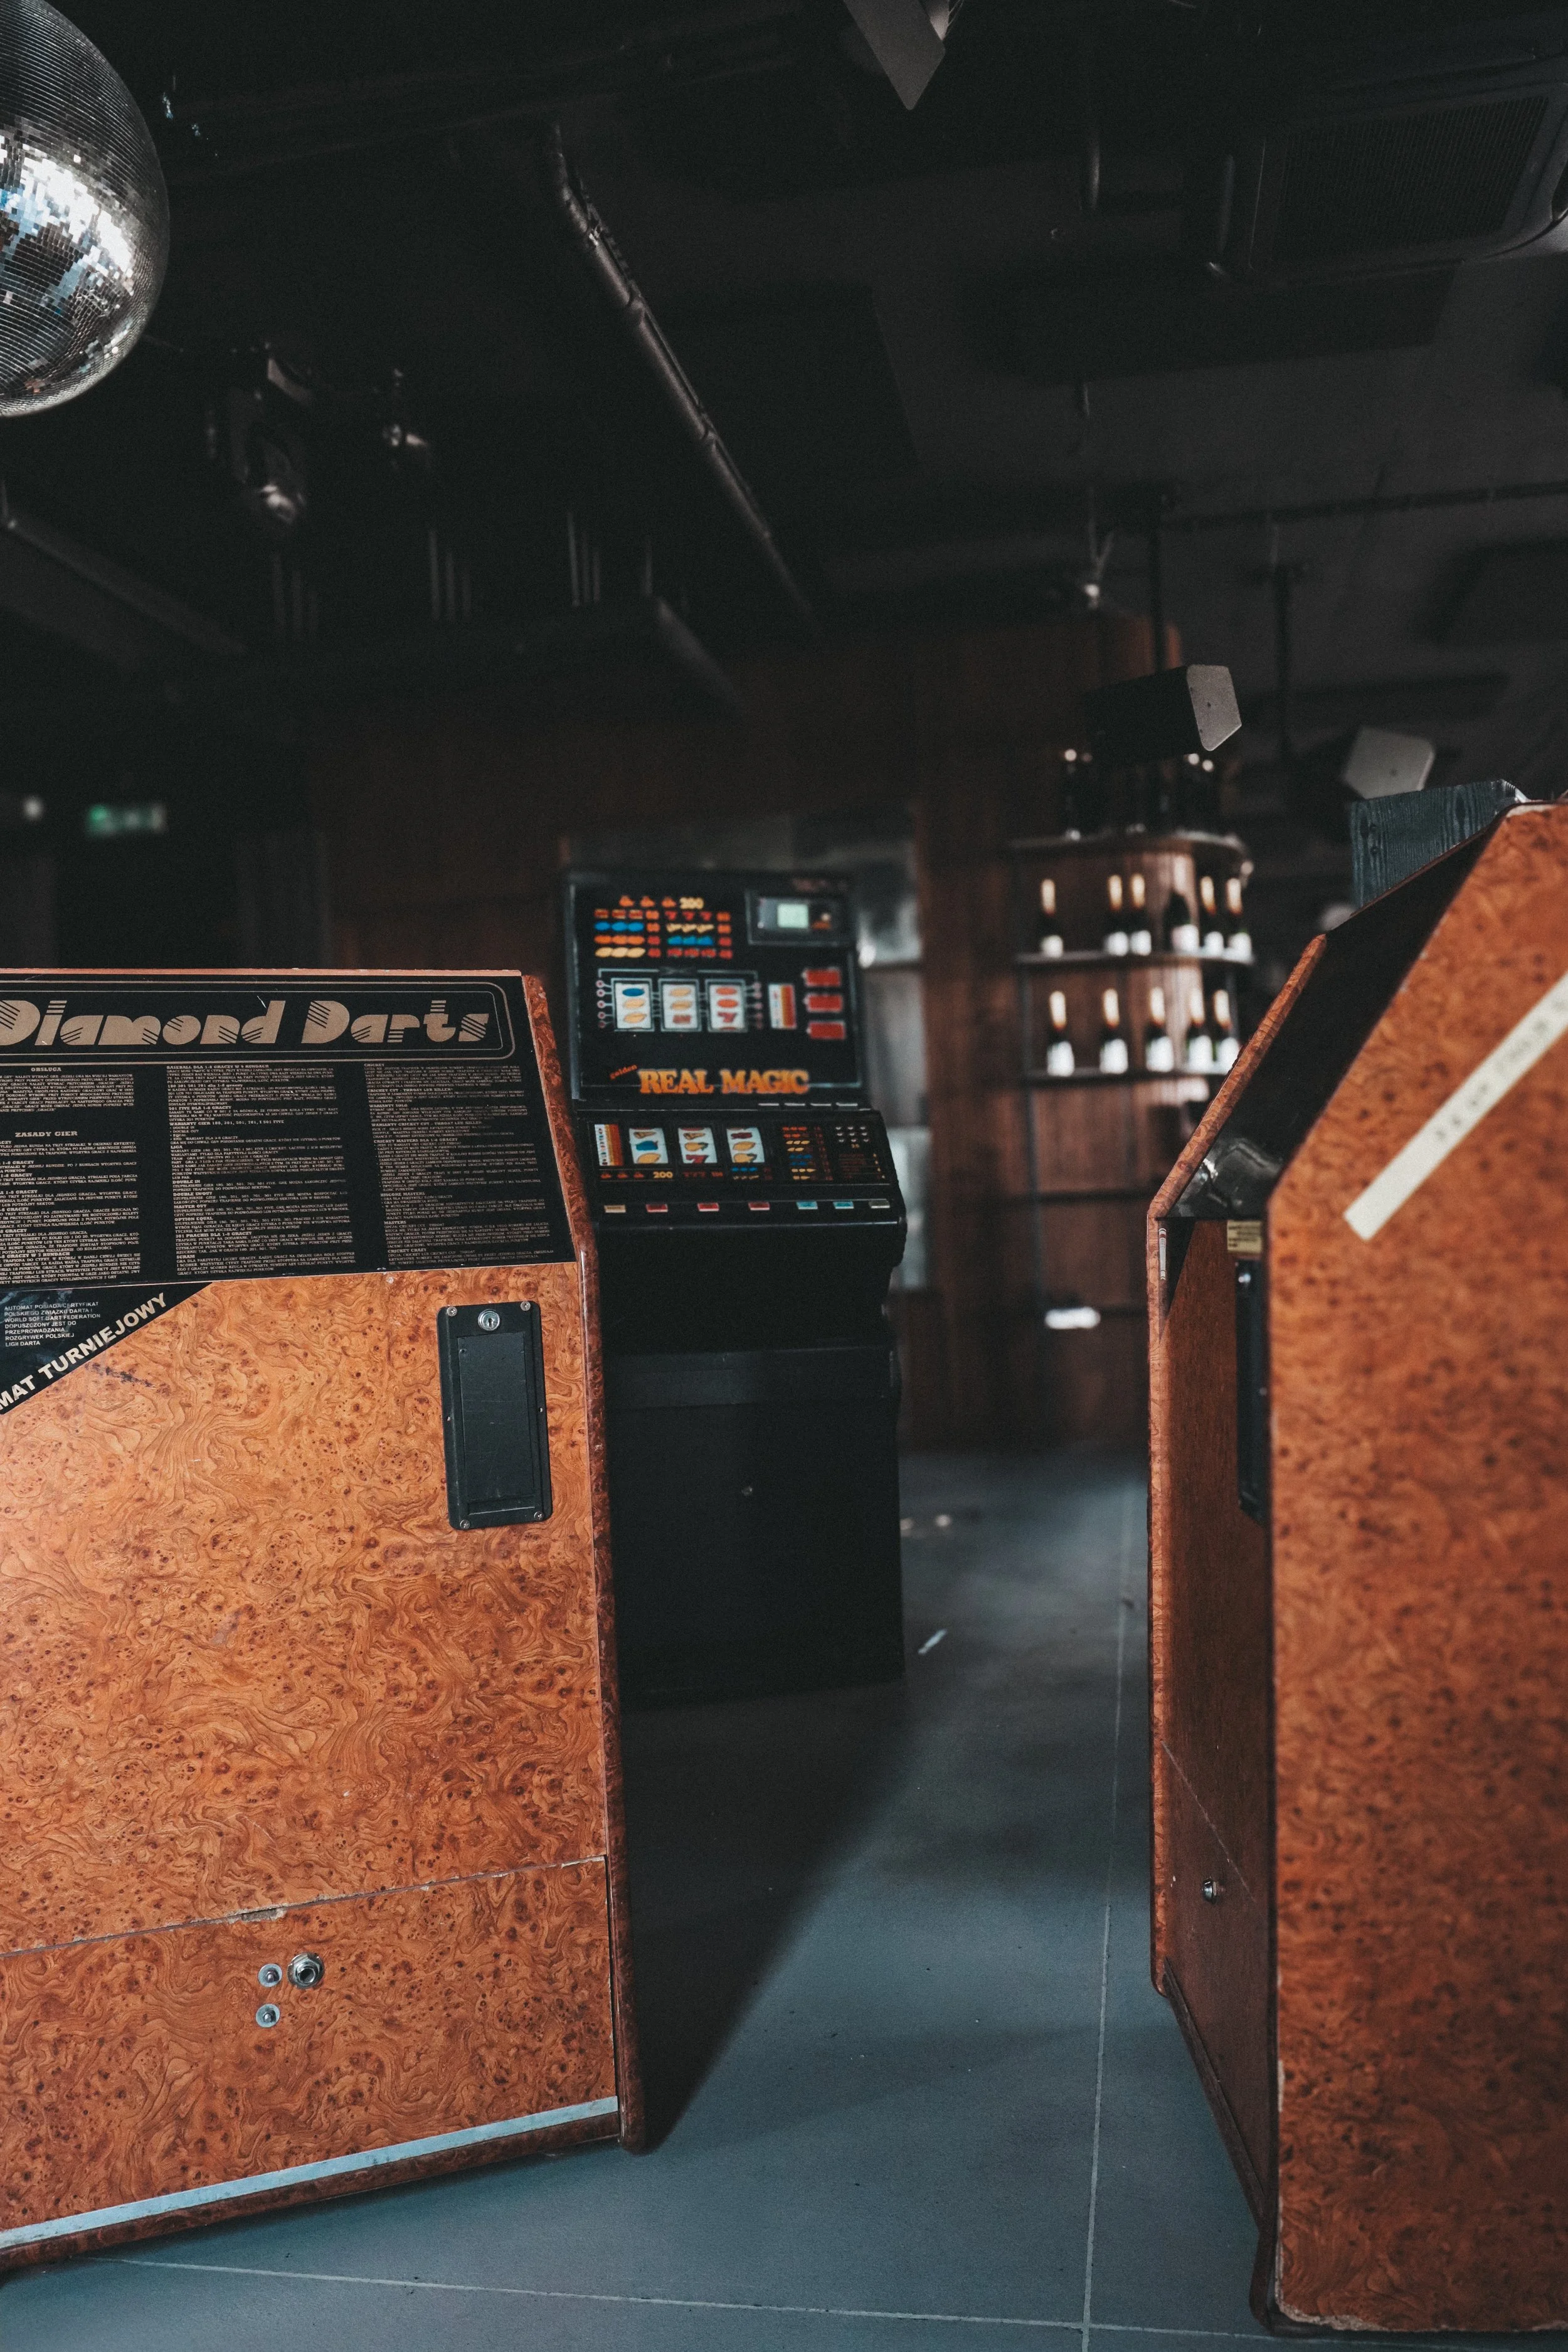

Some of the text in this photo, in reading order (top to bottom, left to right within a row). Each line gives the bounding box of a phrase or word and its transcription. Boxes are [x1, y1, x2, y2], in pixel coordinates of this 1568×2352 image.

[0, 1000, 489, 1046] Diamond Darts
[637, 1068, 809, 1094] REAL MAGIC
[652, 1171, 674, 1179] 200
[38, 1292, 167, 1380] TURNIEJOWY
